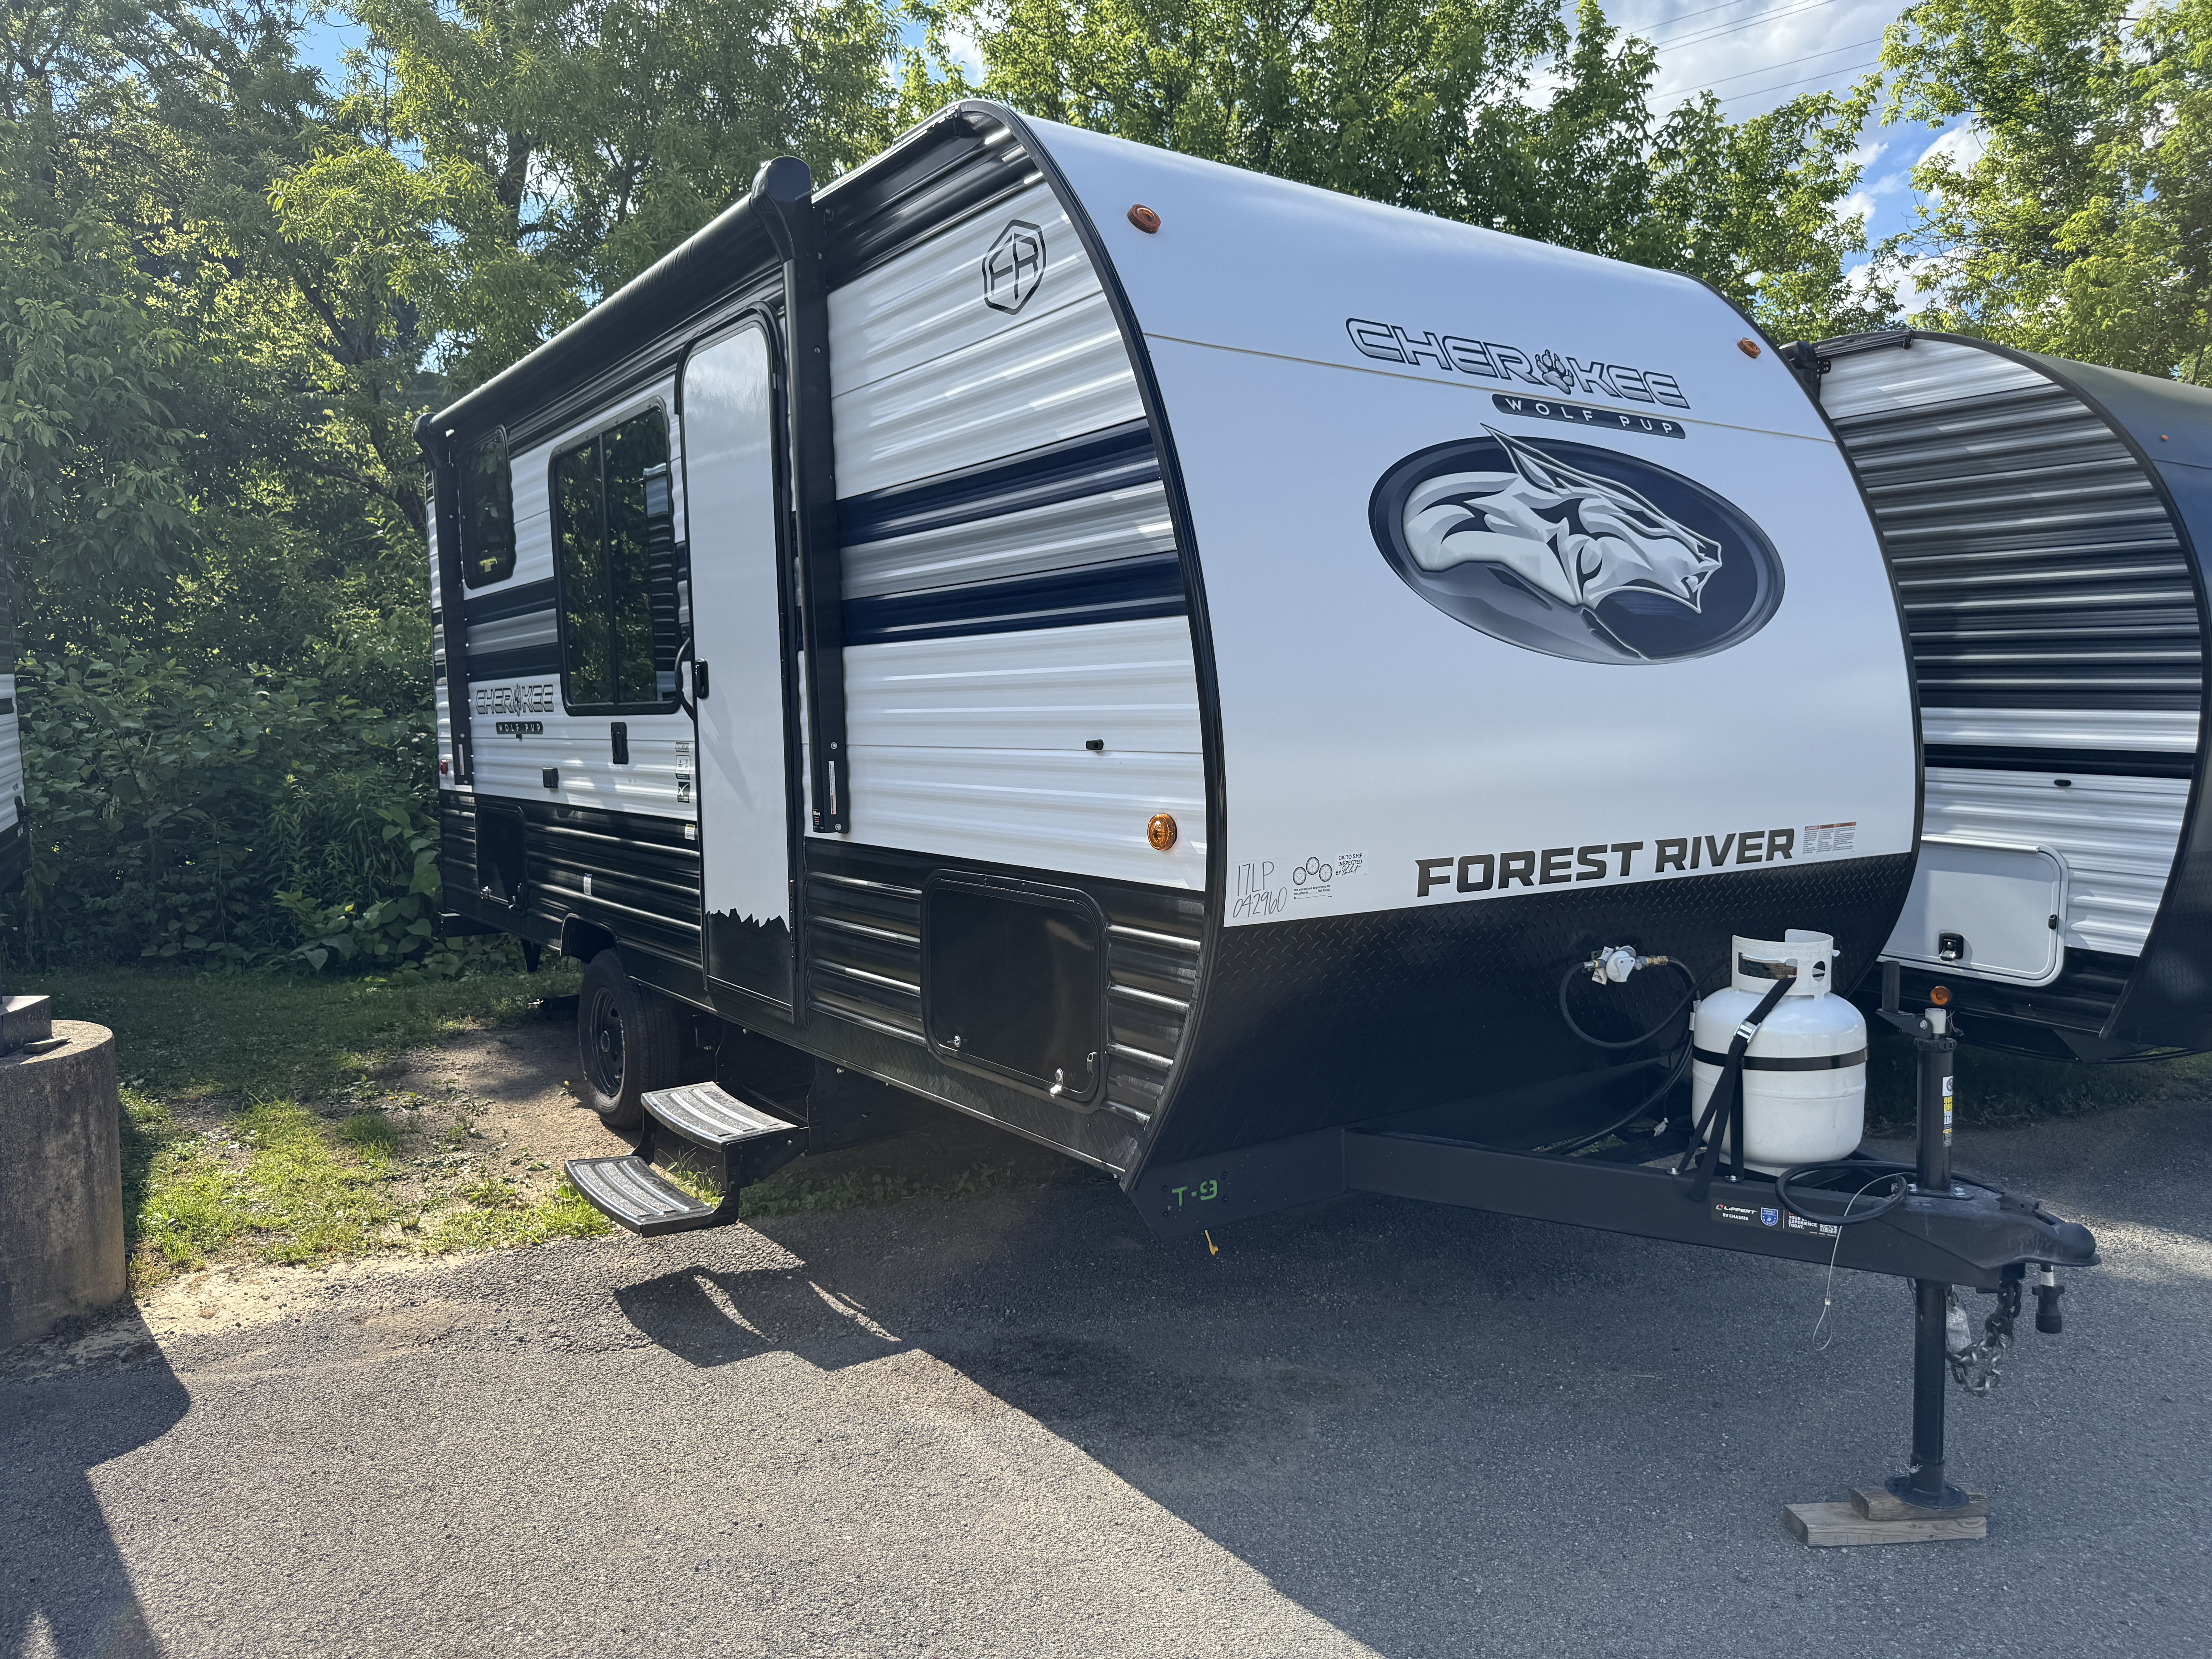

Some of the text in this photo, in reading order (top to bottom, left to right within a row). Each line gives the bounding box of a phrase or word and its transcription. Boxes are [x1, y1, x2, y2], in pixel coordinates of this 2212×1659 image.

[1504, 398, 1673, 434] WOLF PUP
[498, 723, 541, 732] WOLF PUP
[1415, 841, 1644, 897] FOREST
[1654, 828, 1795, 873] RIVER
[1233, 887, 1287, 918] 042960
[1172, 1180, 1218, 1207] T-9
[1724, 1206, 1757, 1214] LIPPERT
[1788, 1219, 1817, 1227] EXPERIENCE
